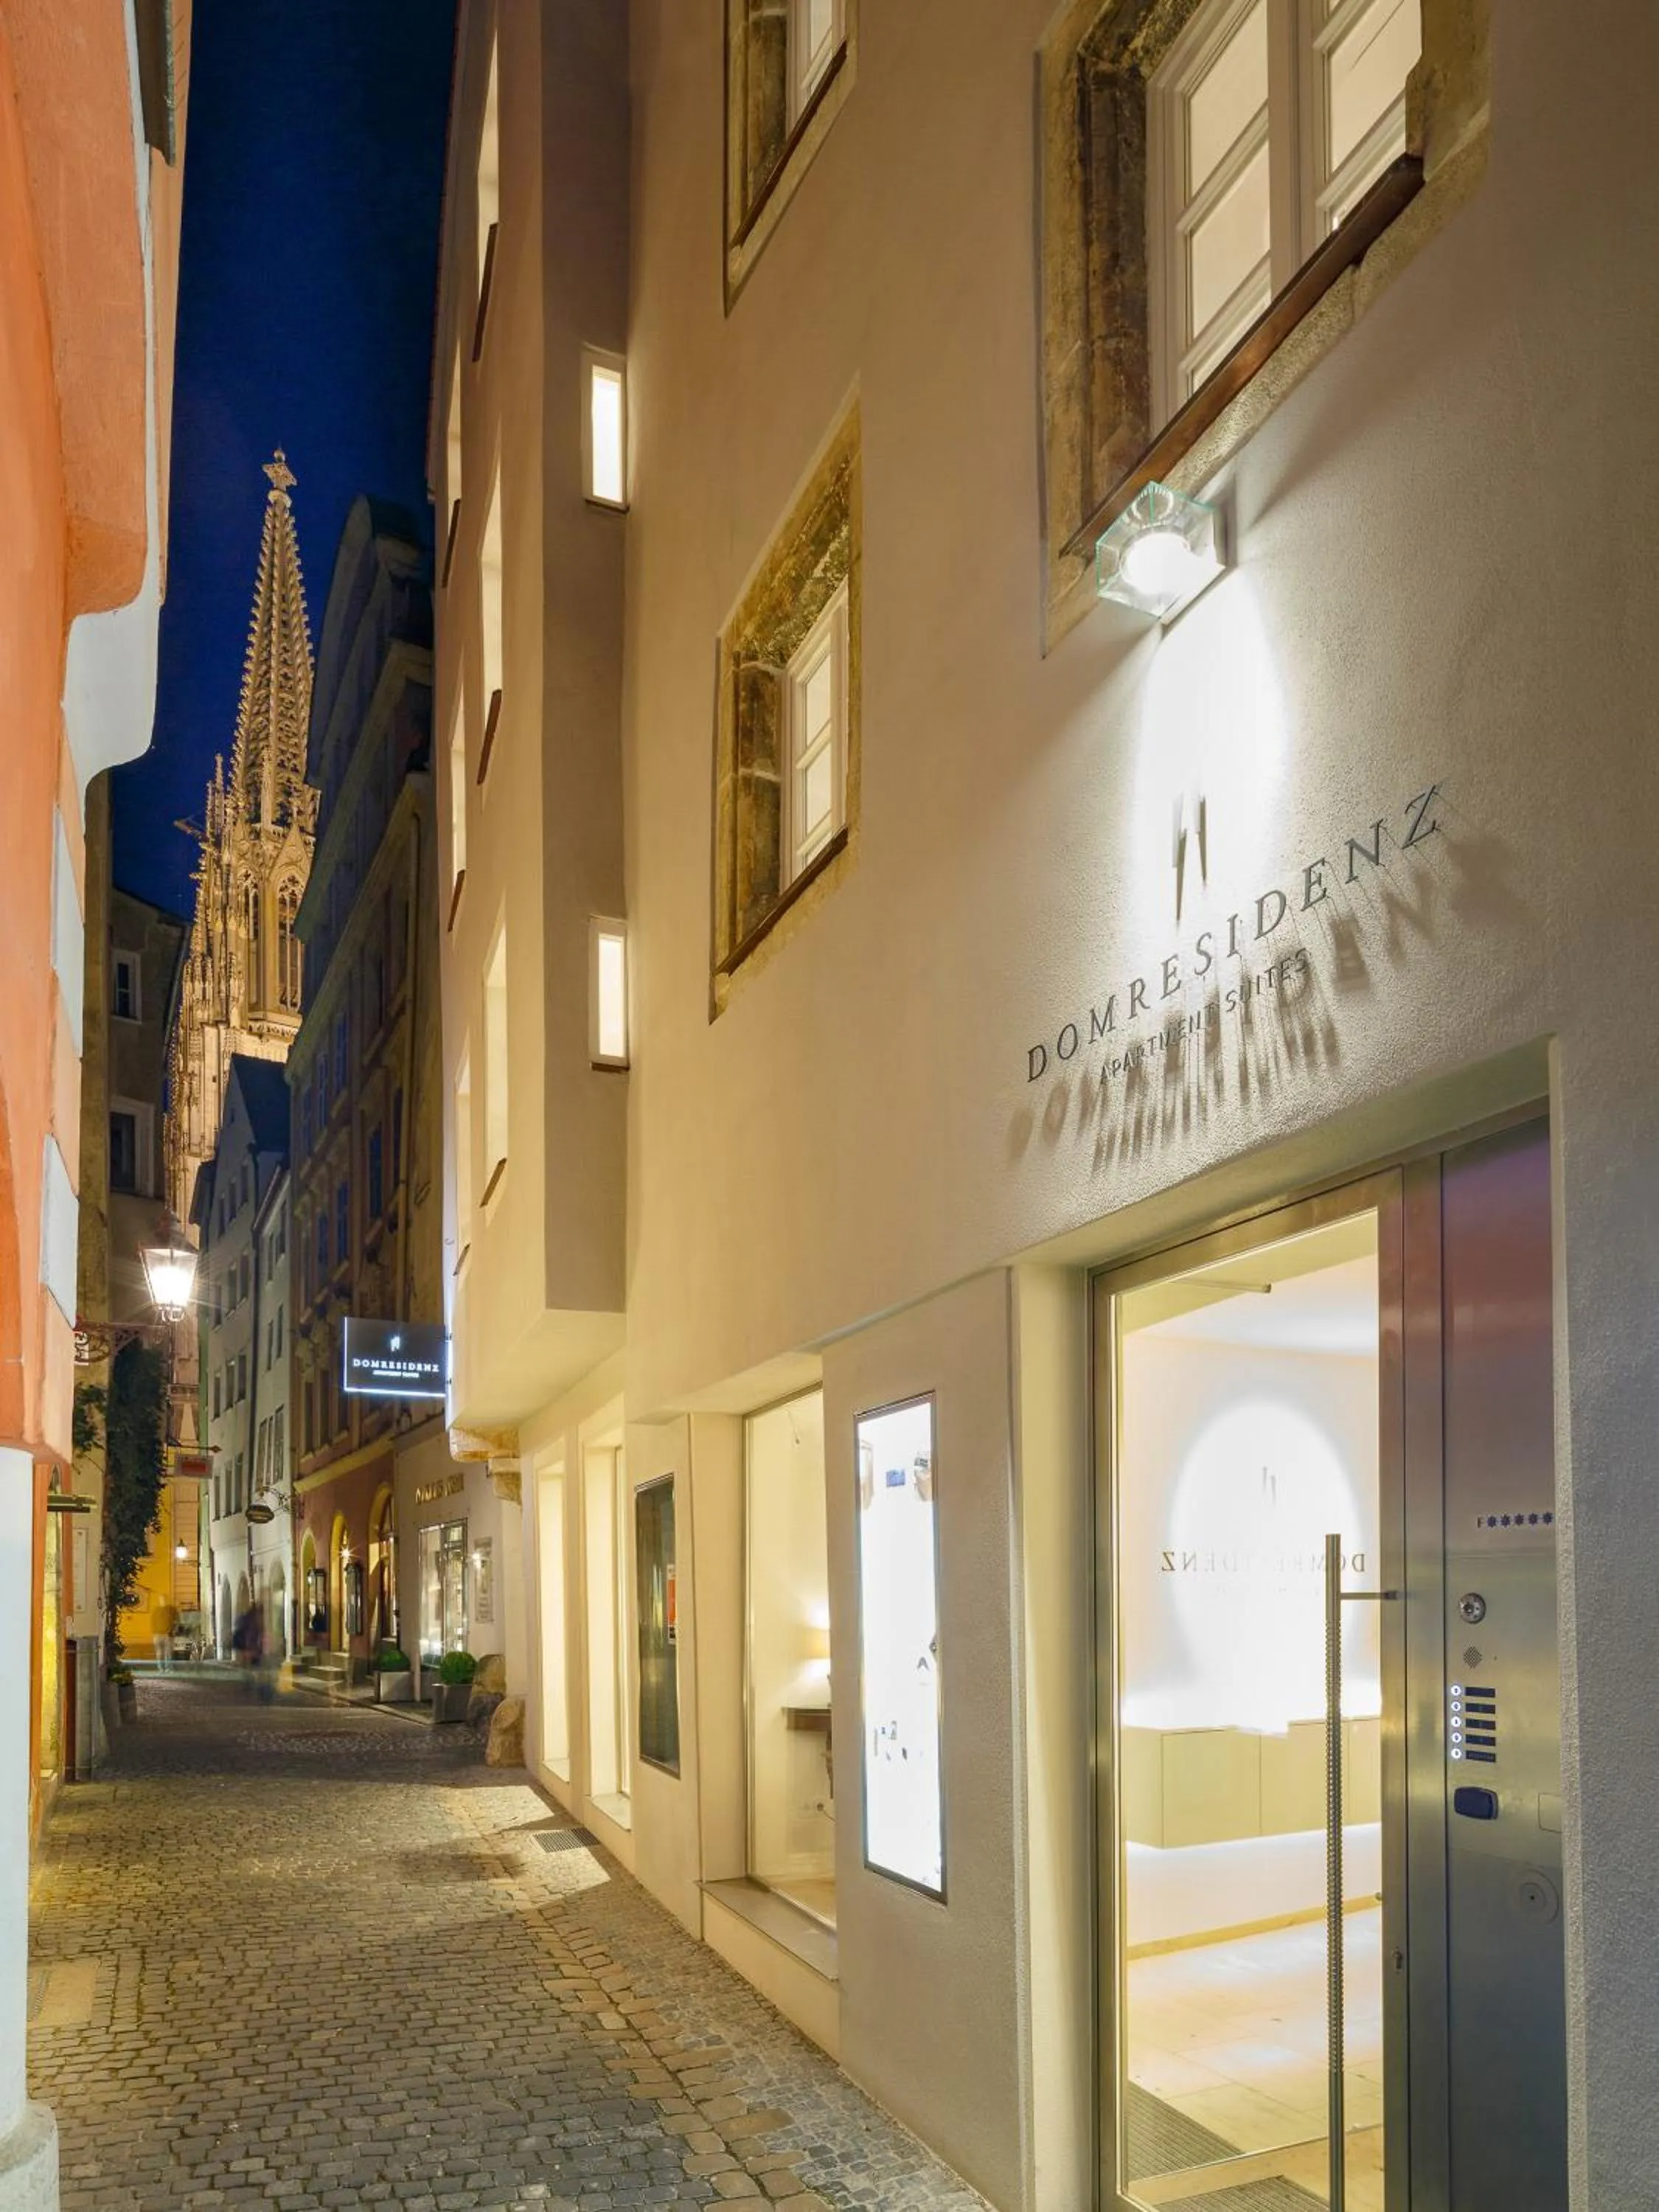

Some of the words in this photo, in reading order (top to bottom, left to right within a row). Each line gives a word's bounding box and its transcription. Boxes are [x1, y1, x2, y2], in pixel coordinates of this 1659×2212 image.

[1027, 784, 1442, 1083] DOMRESIDENZ
[1099, 1002, 1220, 1085] APARTMENT
[1225, 947, 1312, 1012] SUITES
[352, 1358, 439, 1372] DOMRESIDENZ
